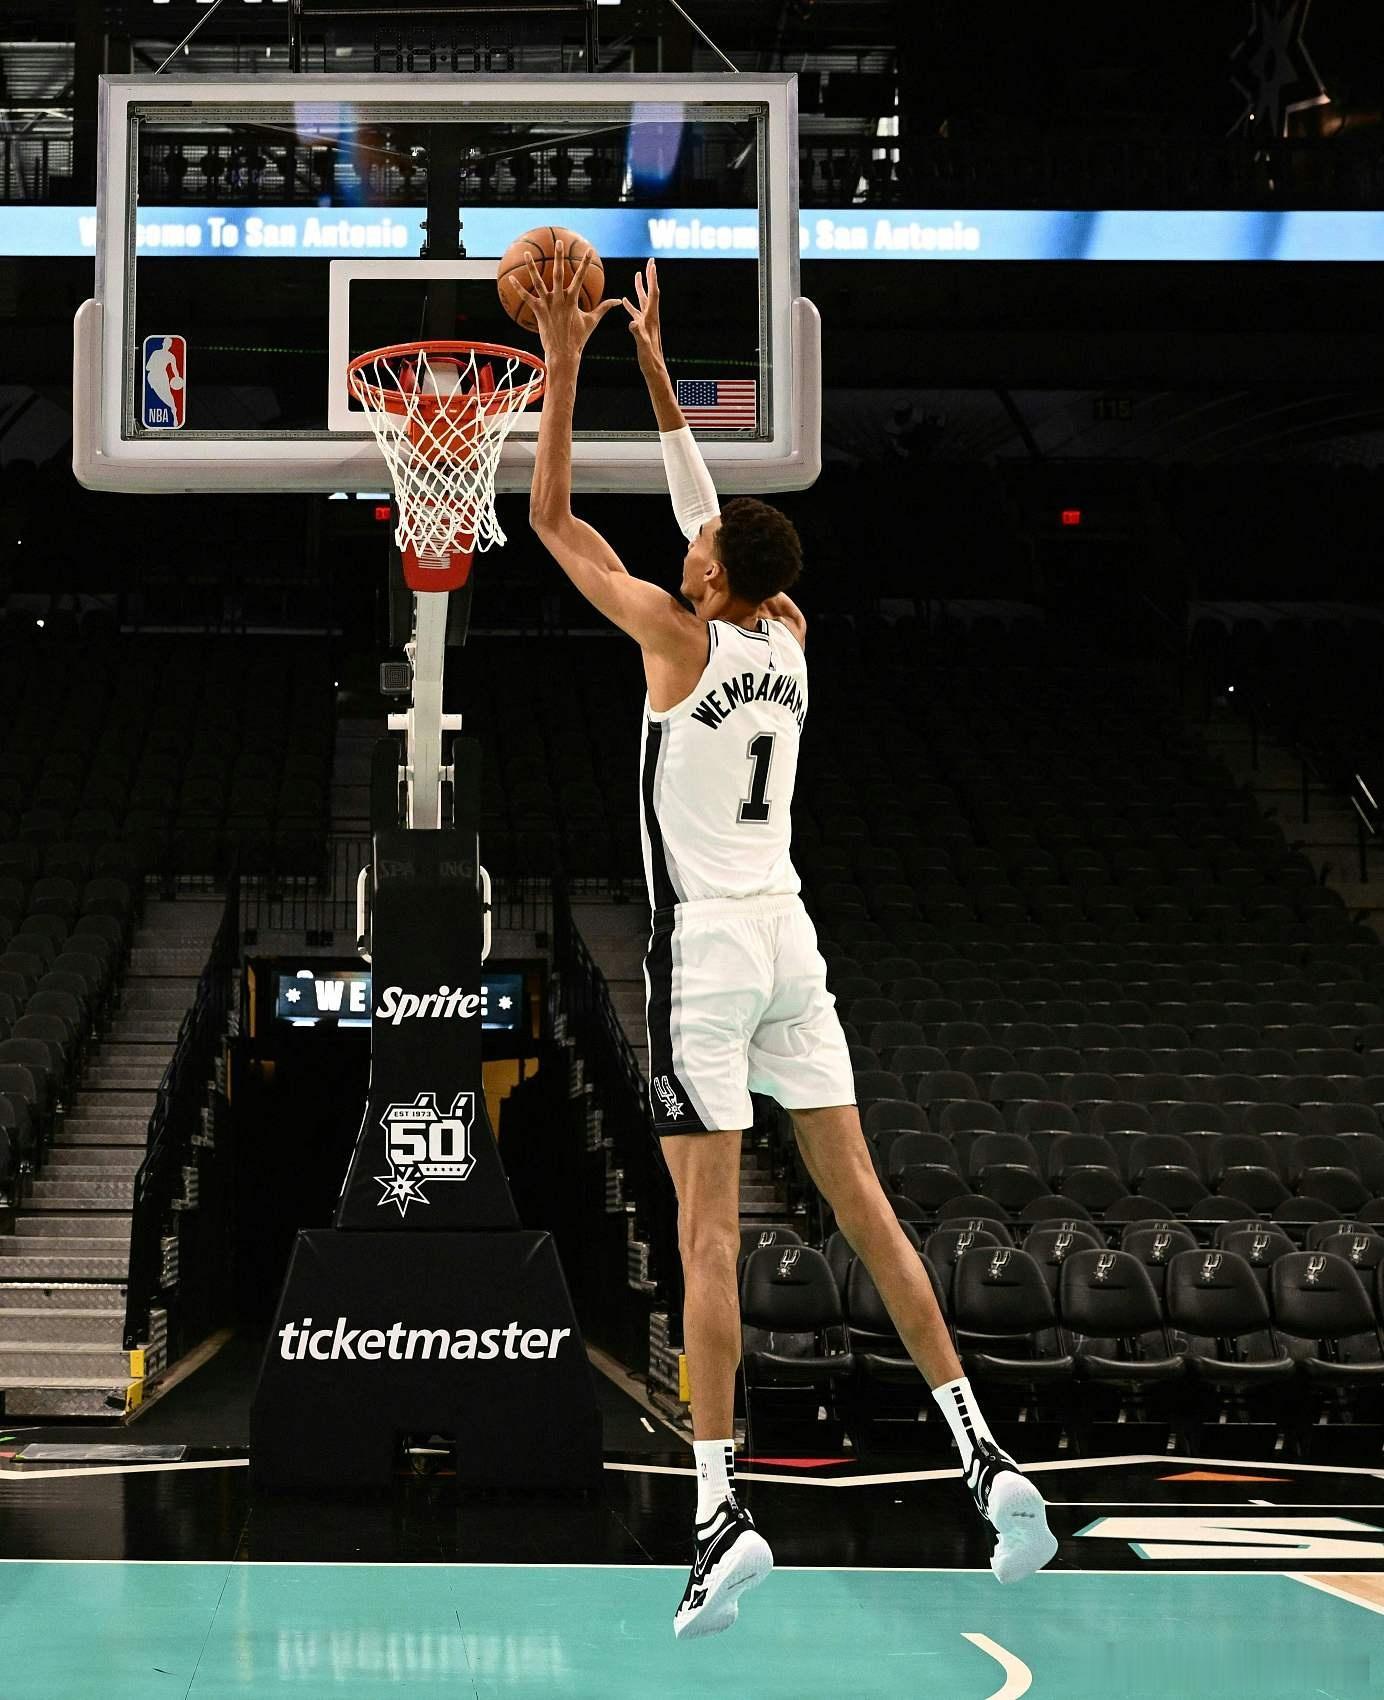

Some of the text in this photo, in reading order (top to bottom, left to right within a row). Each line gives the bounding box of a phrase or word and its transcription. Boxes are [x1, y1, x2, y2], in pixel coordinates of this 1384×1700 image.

[78, 216, 408, 248] Wcome To San Antonio
[647, 218, 759, 249] Welcom
[815, 219, 869, 250] San
[873, 219, 981, 250] Antonio
[148, 408, 169, 423] NBA
[735, 731, 777, 825] 1
[375, 985, 481, 1026] Sprite
[390, 1119, 466, 1165] 50
[278, 1317, 571, 1360] ticketmaster
